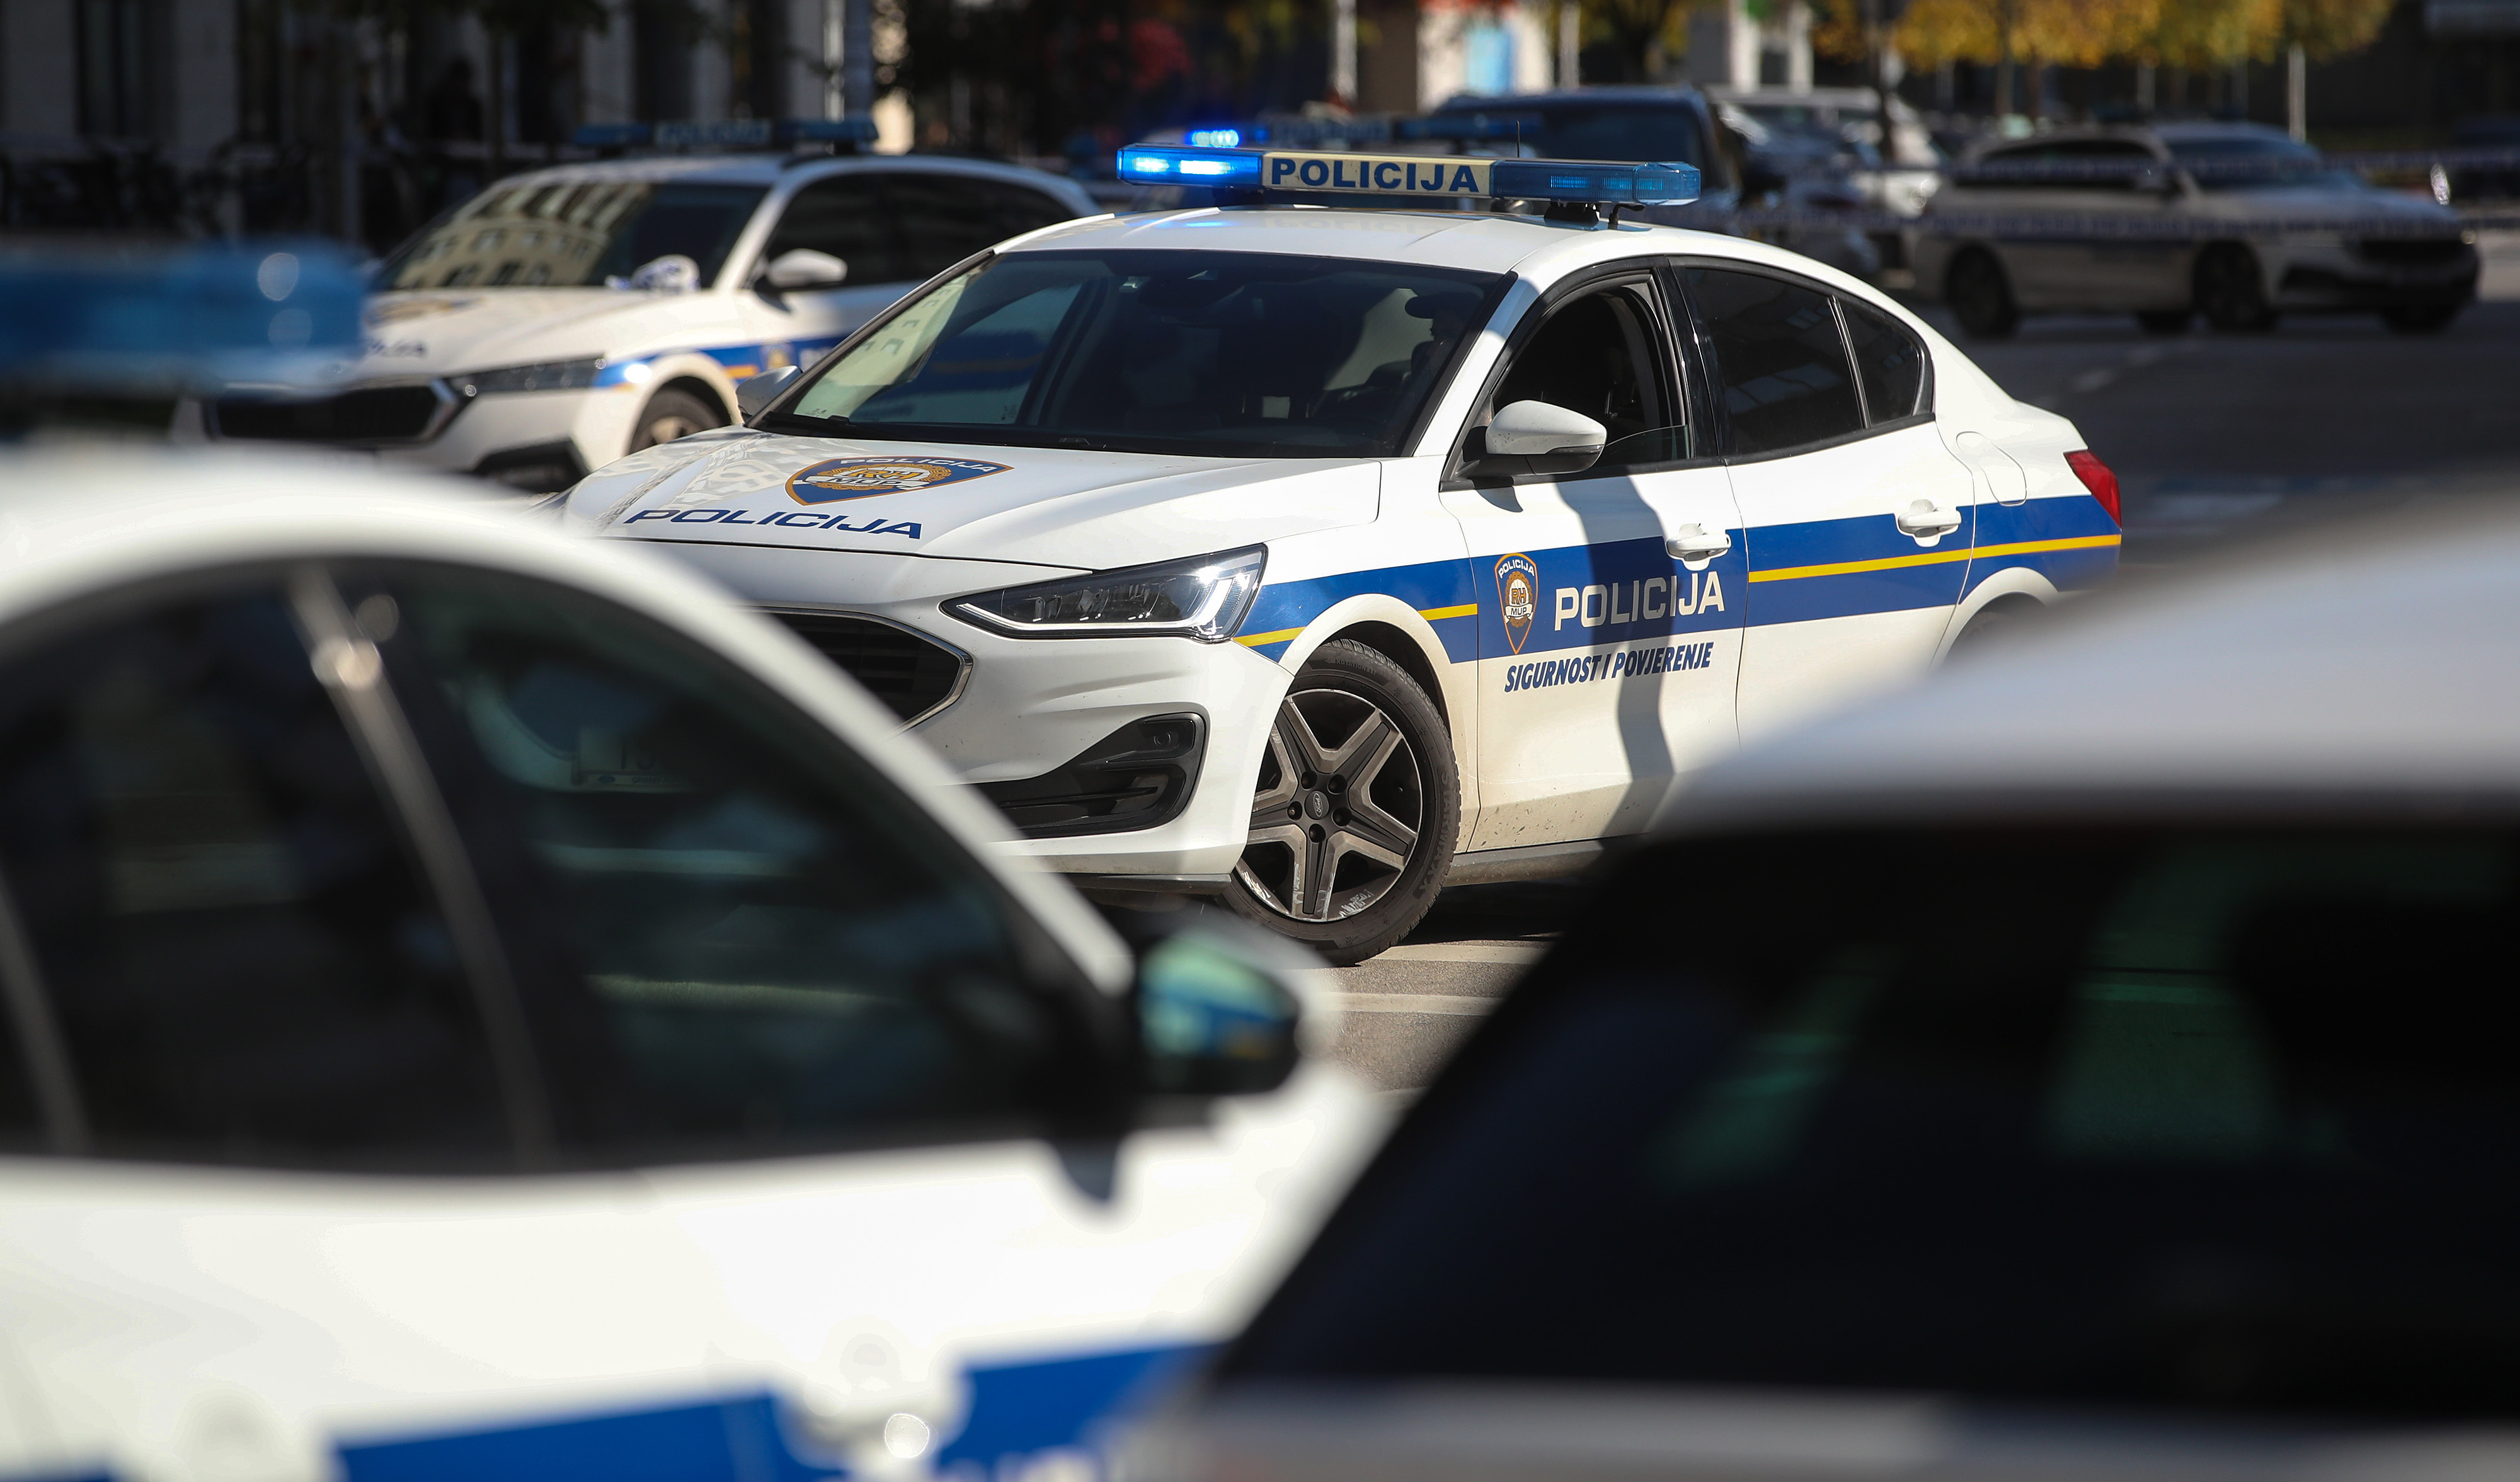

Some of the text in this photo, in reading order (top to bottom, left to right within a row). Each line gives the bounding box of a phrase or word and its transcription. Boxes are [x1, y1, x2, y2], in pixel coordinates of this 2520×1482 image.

[1271, 158, 1479, 192] POLICIJA
[840, 459, 997, 473] POLICIJA
[623, 509, 922, 539] POLICIJA
[1498, 560, 1535, 578] POLICIJA
[1511, 587, 1526, 605] RH
[1554, 571, 1725, 631] POLICIJA
[1511, 607, 1527, 616] MUP
[1504, 641, 1715, 692] SIGURNOST I POVJERENJE
